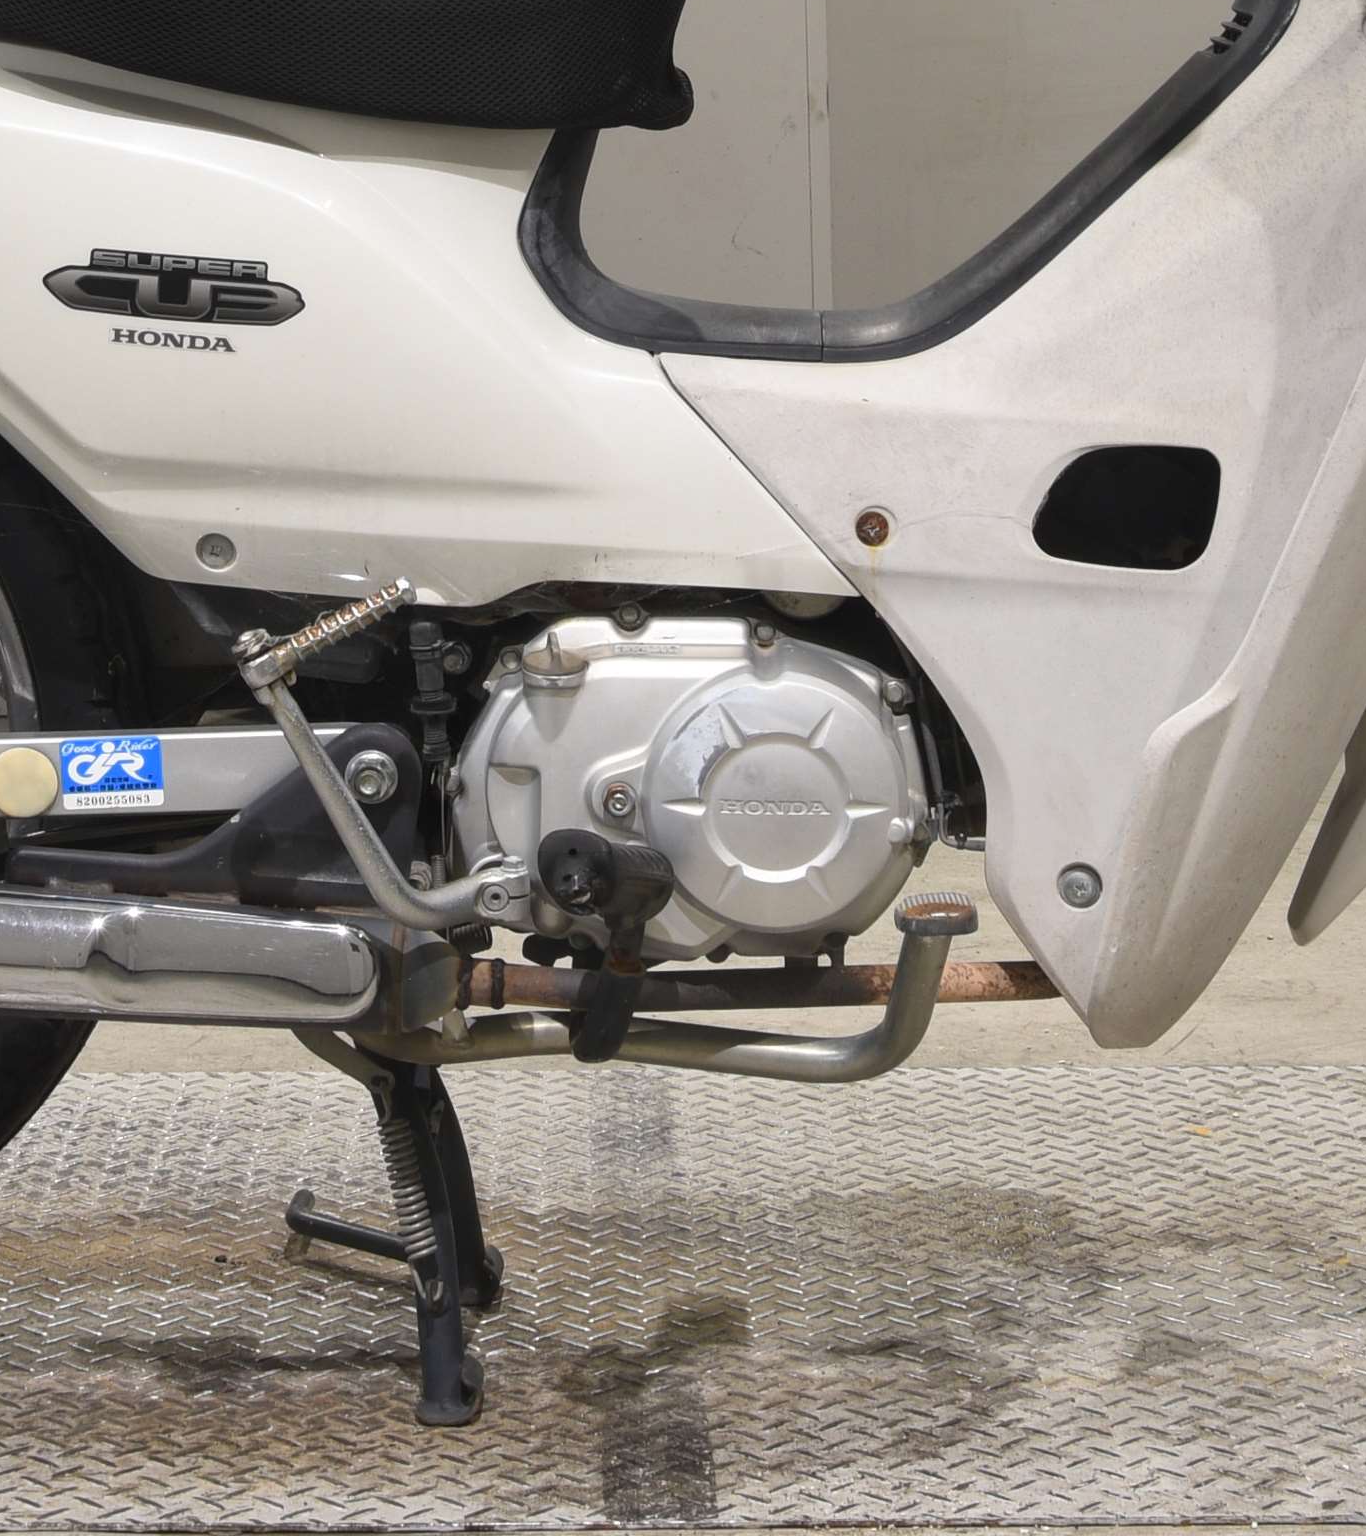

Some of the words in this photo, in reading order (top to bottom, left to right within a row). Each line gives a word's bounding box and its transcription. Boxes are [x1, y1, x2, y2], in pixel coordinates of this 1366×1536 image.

[92, 250, 267, 279] SUPER
[111, 328, 237, 352] HONDA
[61, 741, 103, 757] Good
[115, 738, 159, 754] Rider
[719, 799, 832, 816] HONDA
